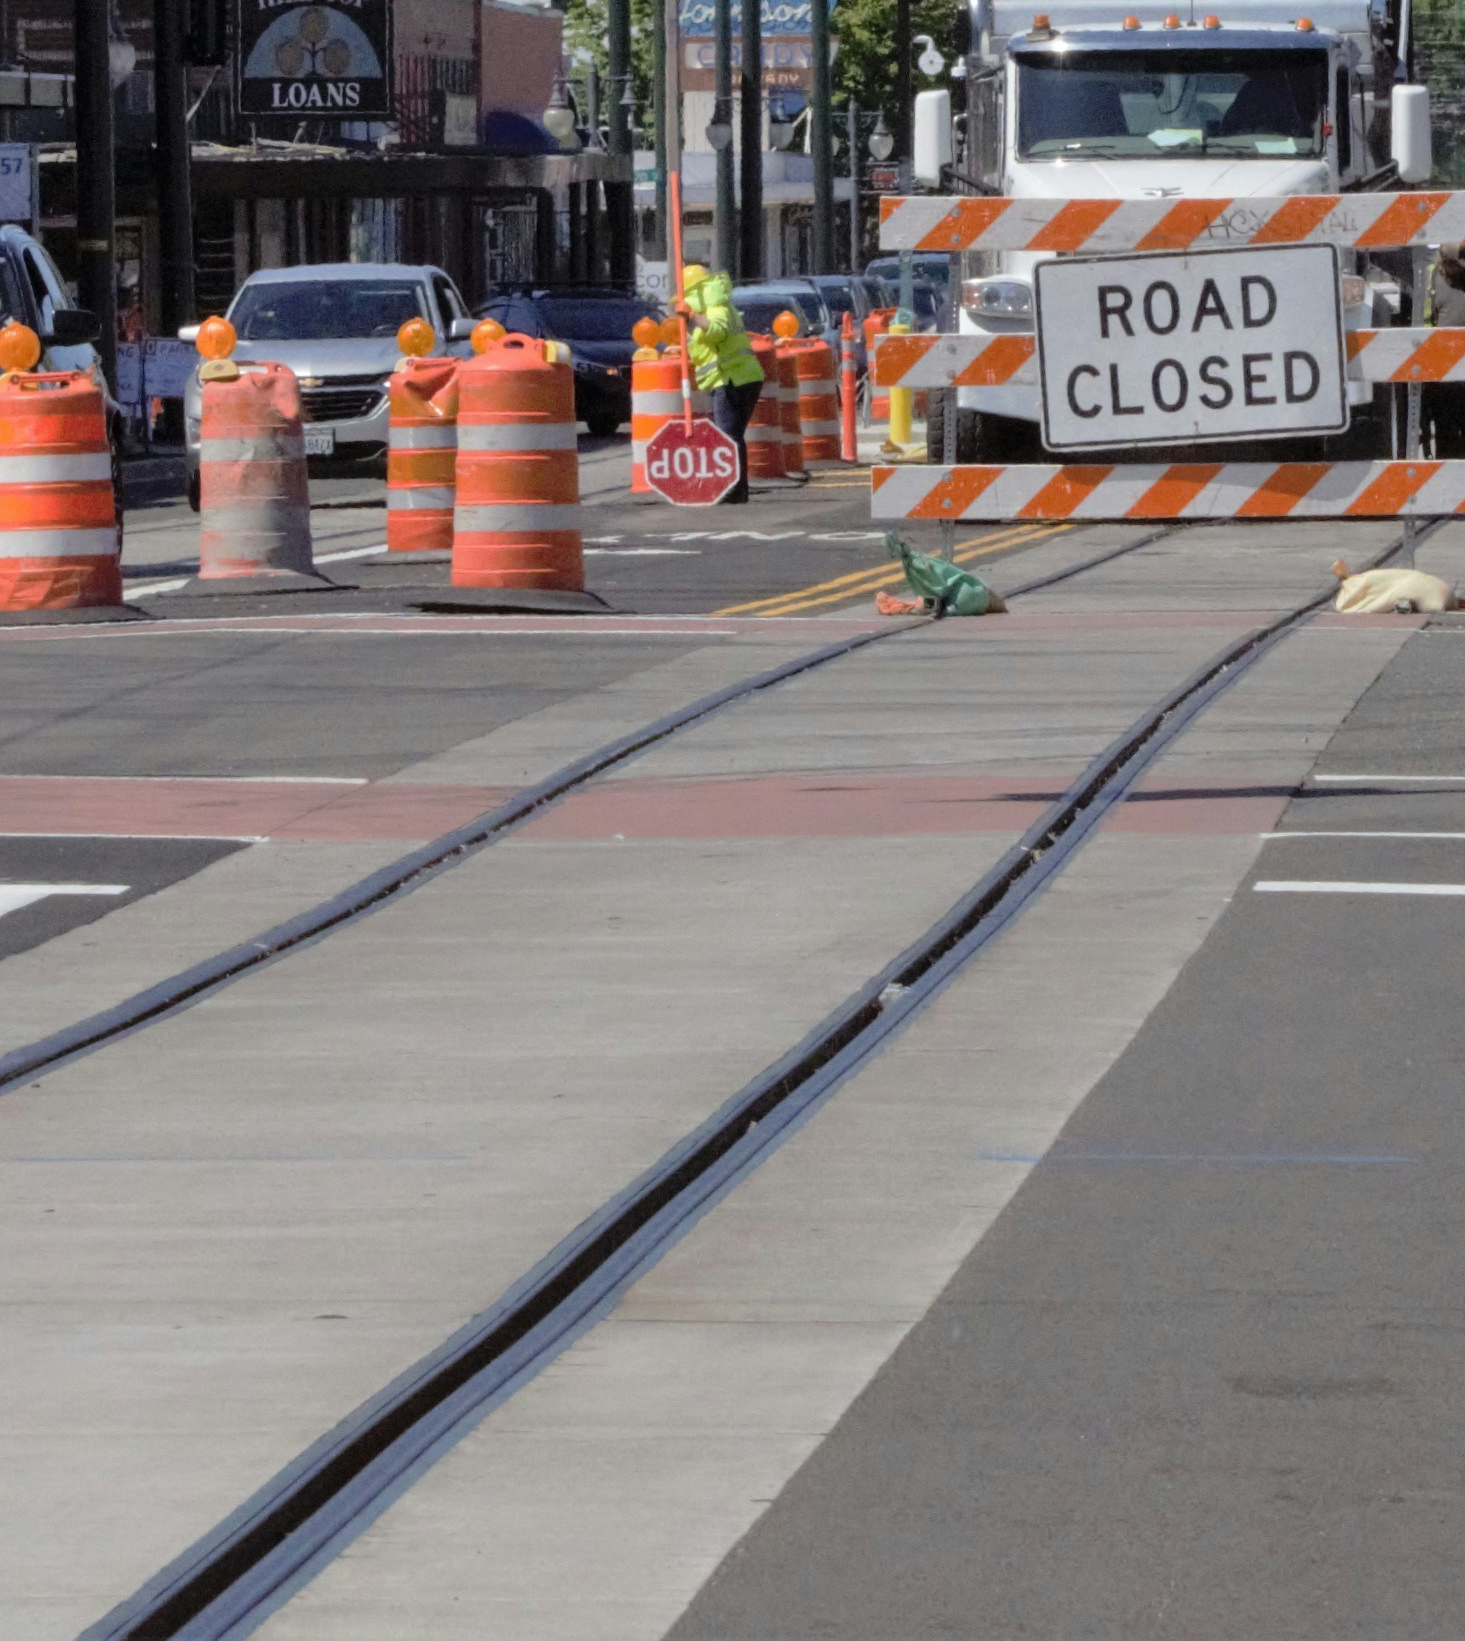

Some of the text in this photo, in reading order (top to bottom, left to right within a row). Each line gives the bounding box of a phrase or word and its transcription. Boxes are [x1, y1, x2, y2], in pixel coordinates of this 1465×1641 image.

[272, 82, 361, 108] LOANS
[0, 158, 23, 175] 57
[1098, 275, 1277, 338] ROAD
[1067, 350, 1320, 418] CLOSED
[650, 446, 733, 479] STOP
